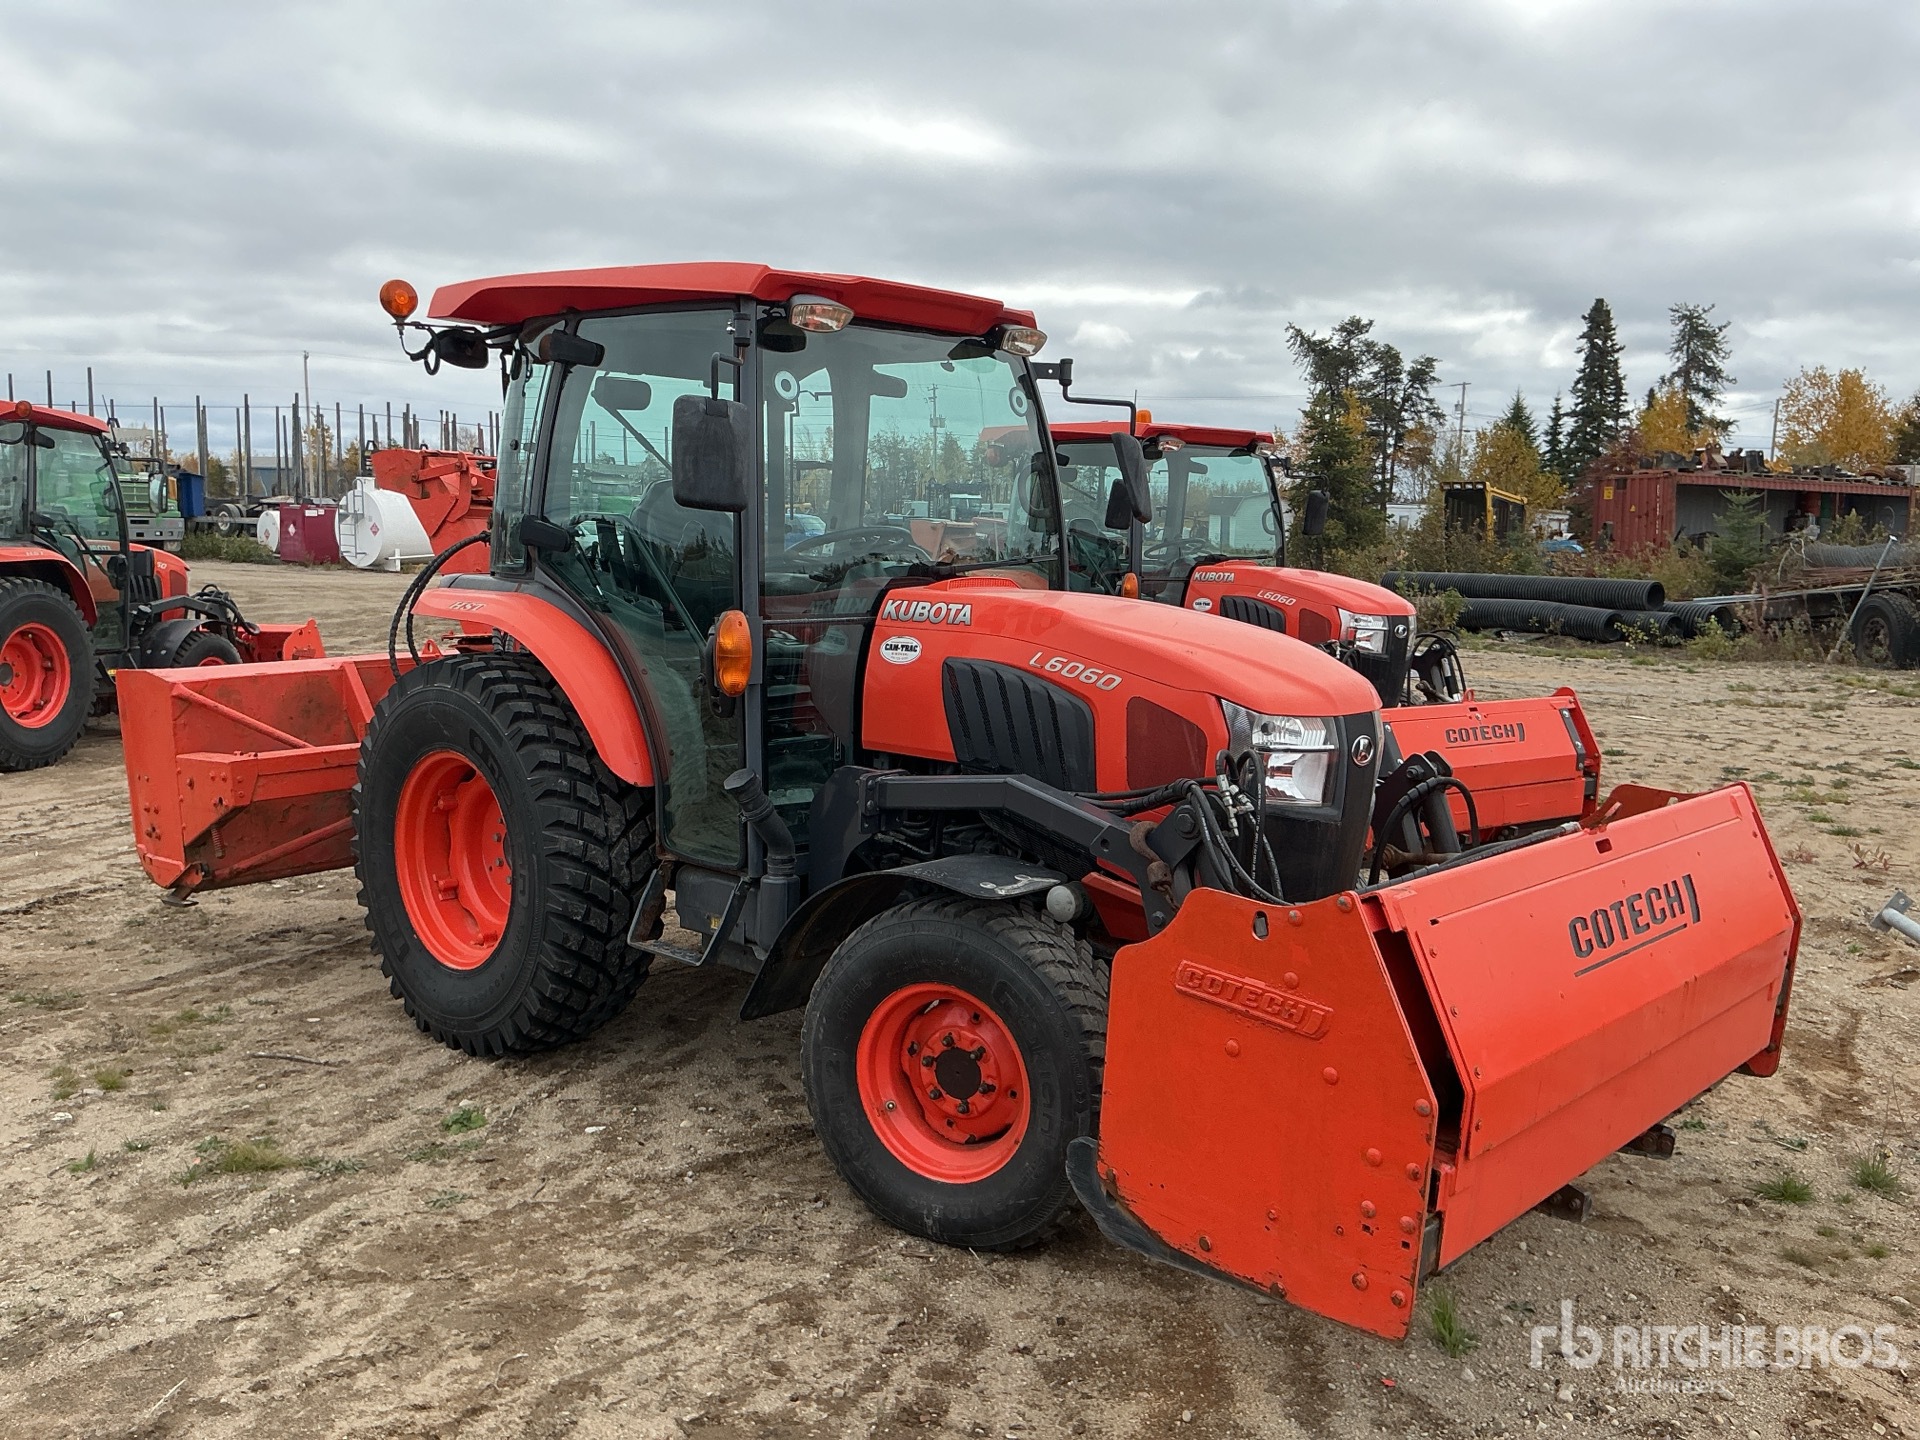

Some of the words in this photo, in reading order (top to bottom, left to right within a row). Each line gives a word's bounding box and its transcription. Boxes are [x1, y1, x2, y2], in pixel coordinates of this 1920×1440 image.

[1194, 572, 1234, 582] KUBOTA
[449, 602, 486, 612] HST
[1257, 590, 1297, 606] L6060
[882, 600, 972, 626] KUBOTA
[885, 643, 918, 653] CAN-TRAC
[1029, 652, 1122, 691] L6060
[1445, 724, 1516, 744] COTECH
[1568, 879, 1686, 958] COTECH
[1183, 968, 1306, 1023] COTECH
